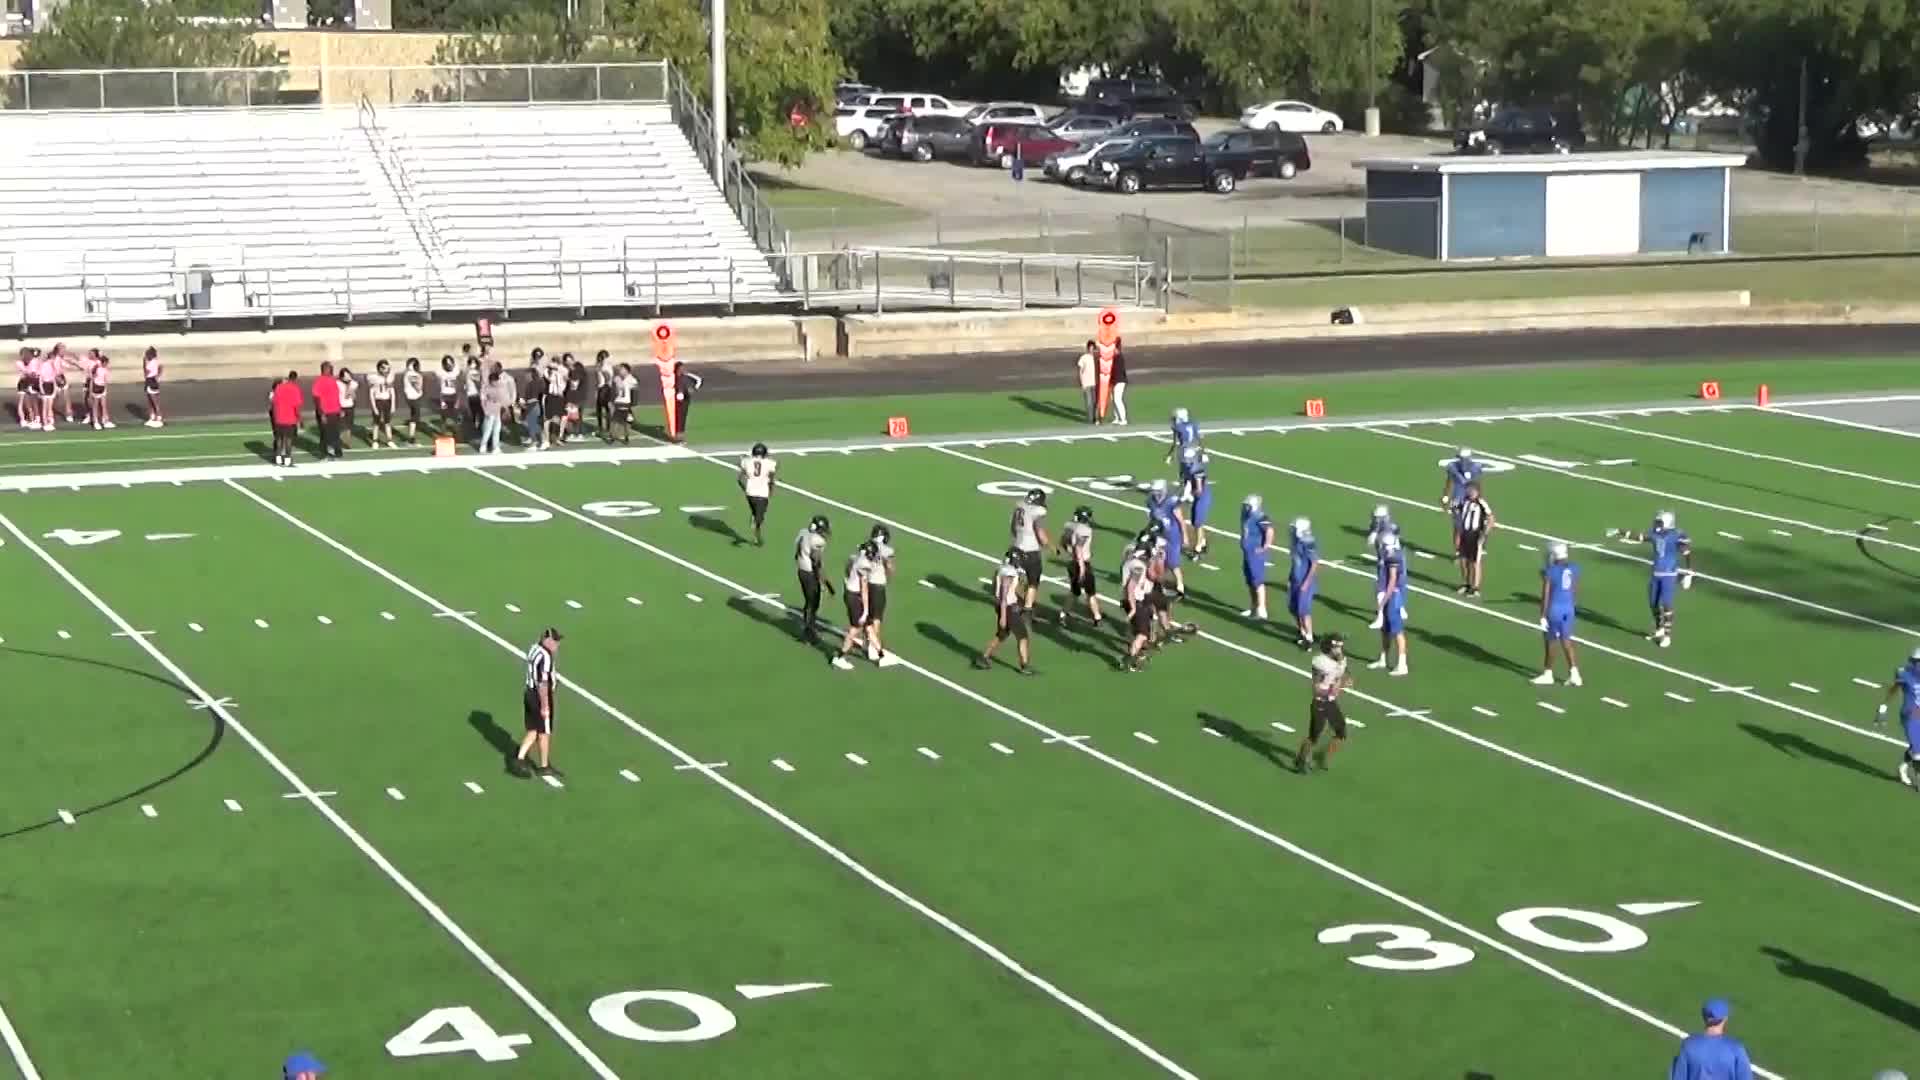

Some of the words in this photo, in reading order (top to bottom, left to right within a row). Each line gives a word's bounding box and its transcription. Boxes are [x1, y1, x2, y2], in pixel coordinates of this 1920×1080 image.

[1562, 568, 1574, 590] 6
[1317, 907, 1649, 970] 30
[385, 990, 737, 1062] 40
